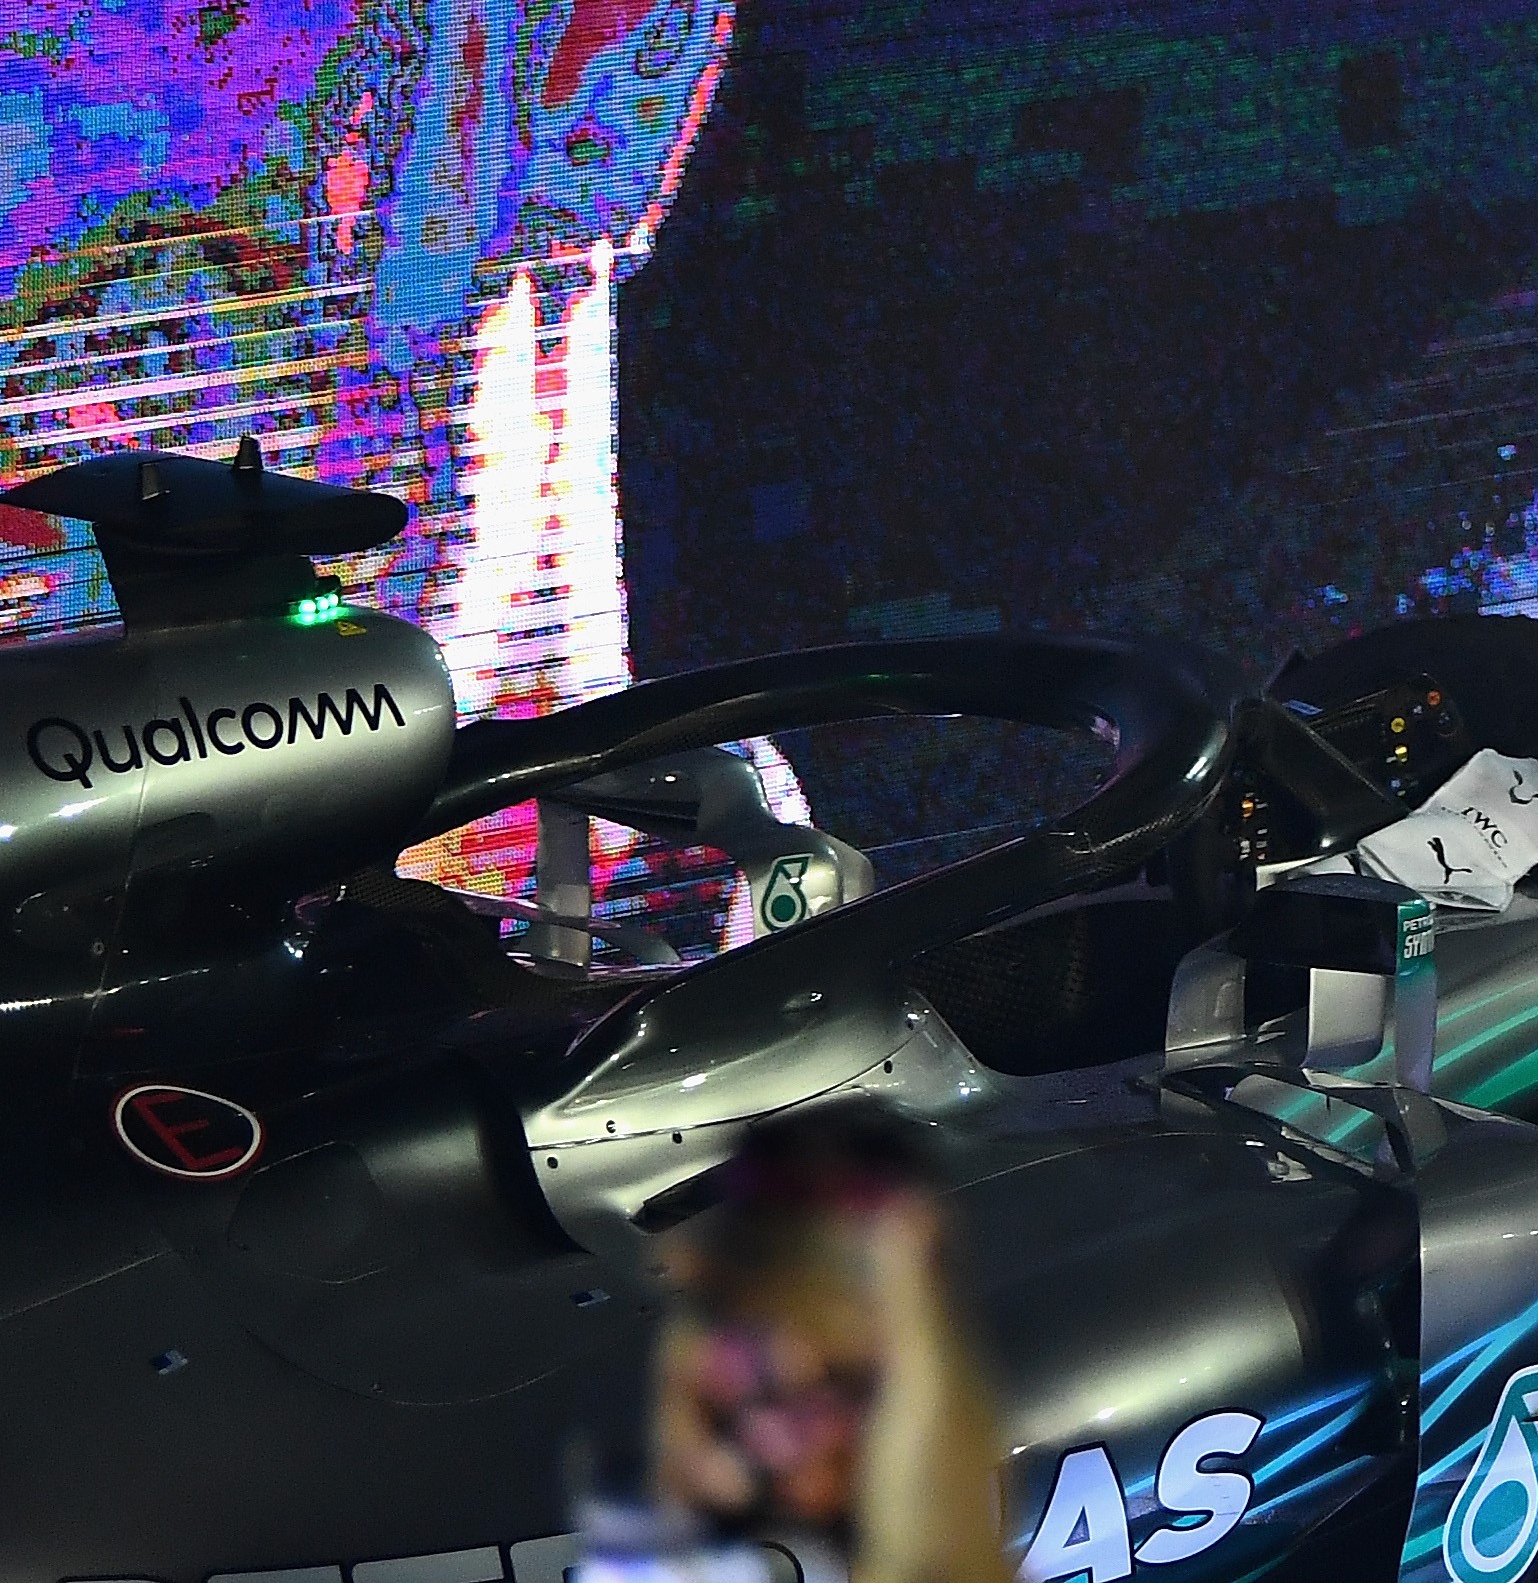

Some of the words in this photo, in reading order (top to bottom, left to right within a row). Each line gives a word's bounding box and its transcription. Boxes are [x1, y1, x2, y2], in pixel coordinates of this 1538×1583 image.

[26, 683, 406, 790] Qualcomm
[1461, 807, 1508, 849] IWC
[132, 1093, 246, 1169] E
